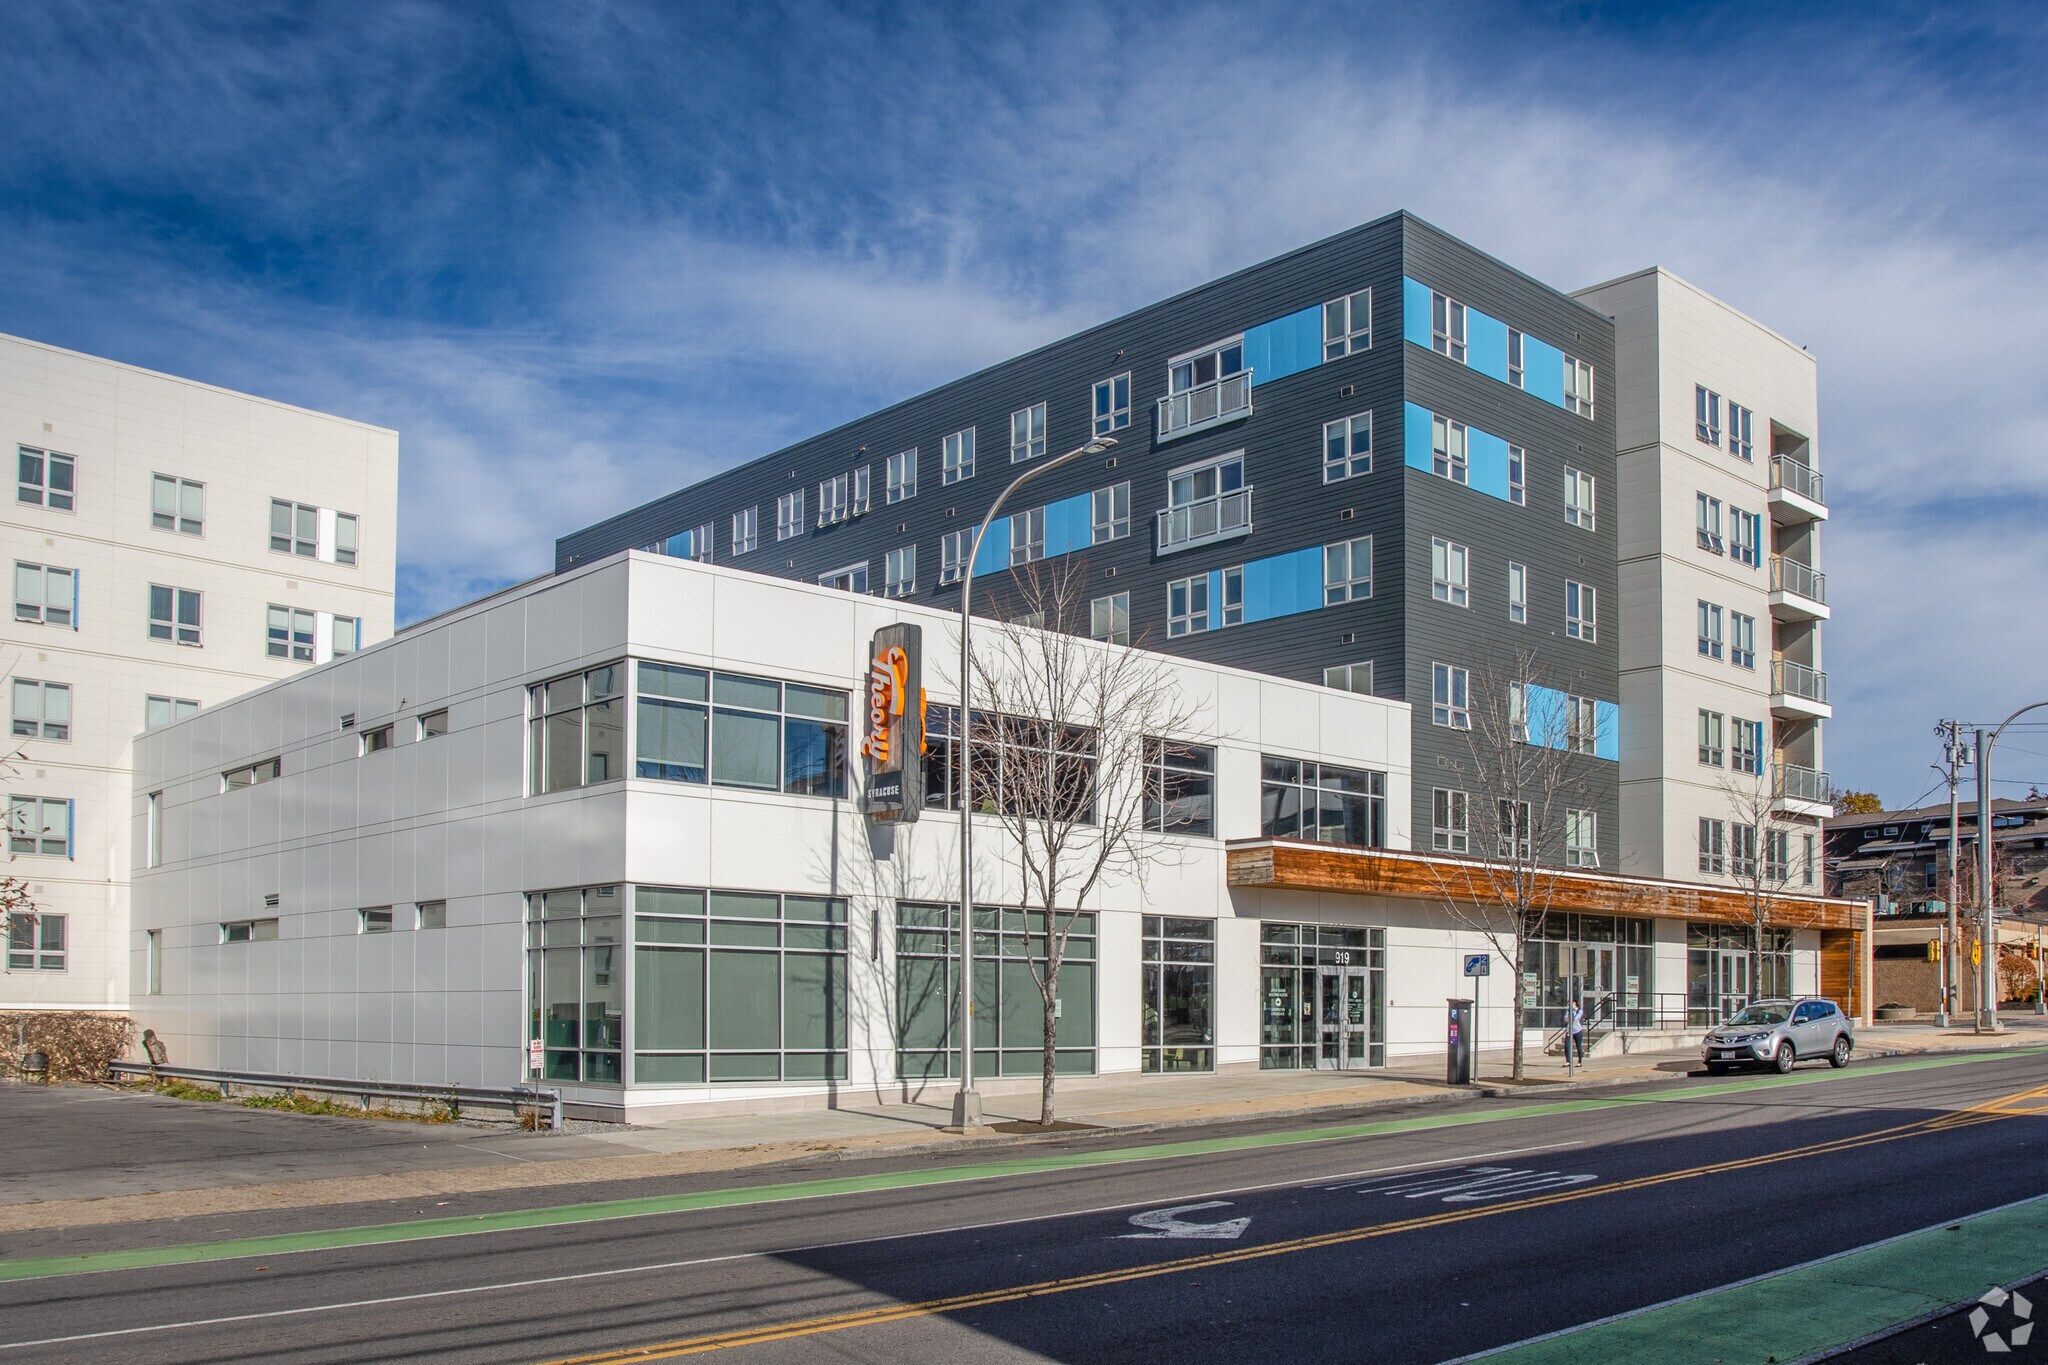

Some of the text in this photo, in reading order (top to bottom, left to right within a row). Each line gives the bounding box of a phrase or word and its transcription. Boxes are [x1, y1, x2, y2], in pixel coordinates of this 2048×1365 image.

[860, 646, 907, 760] Theory
[867, 785, 900, 799] SYRACUSE
[1335, 951, 1350, 964] 919
[1481, 955, 1487, 964] 2
[1451, 1009, 1457, 1018] P
